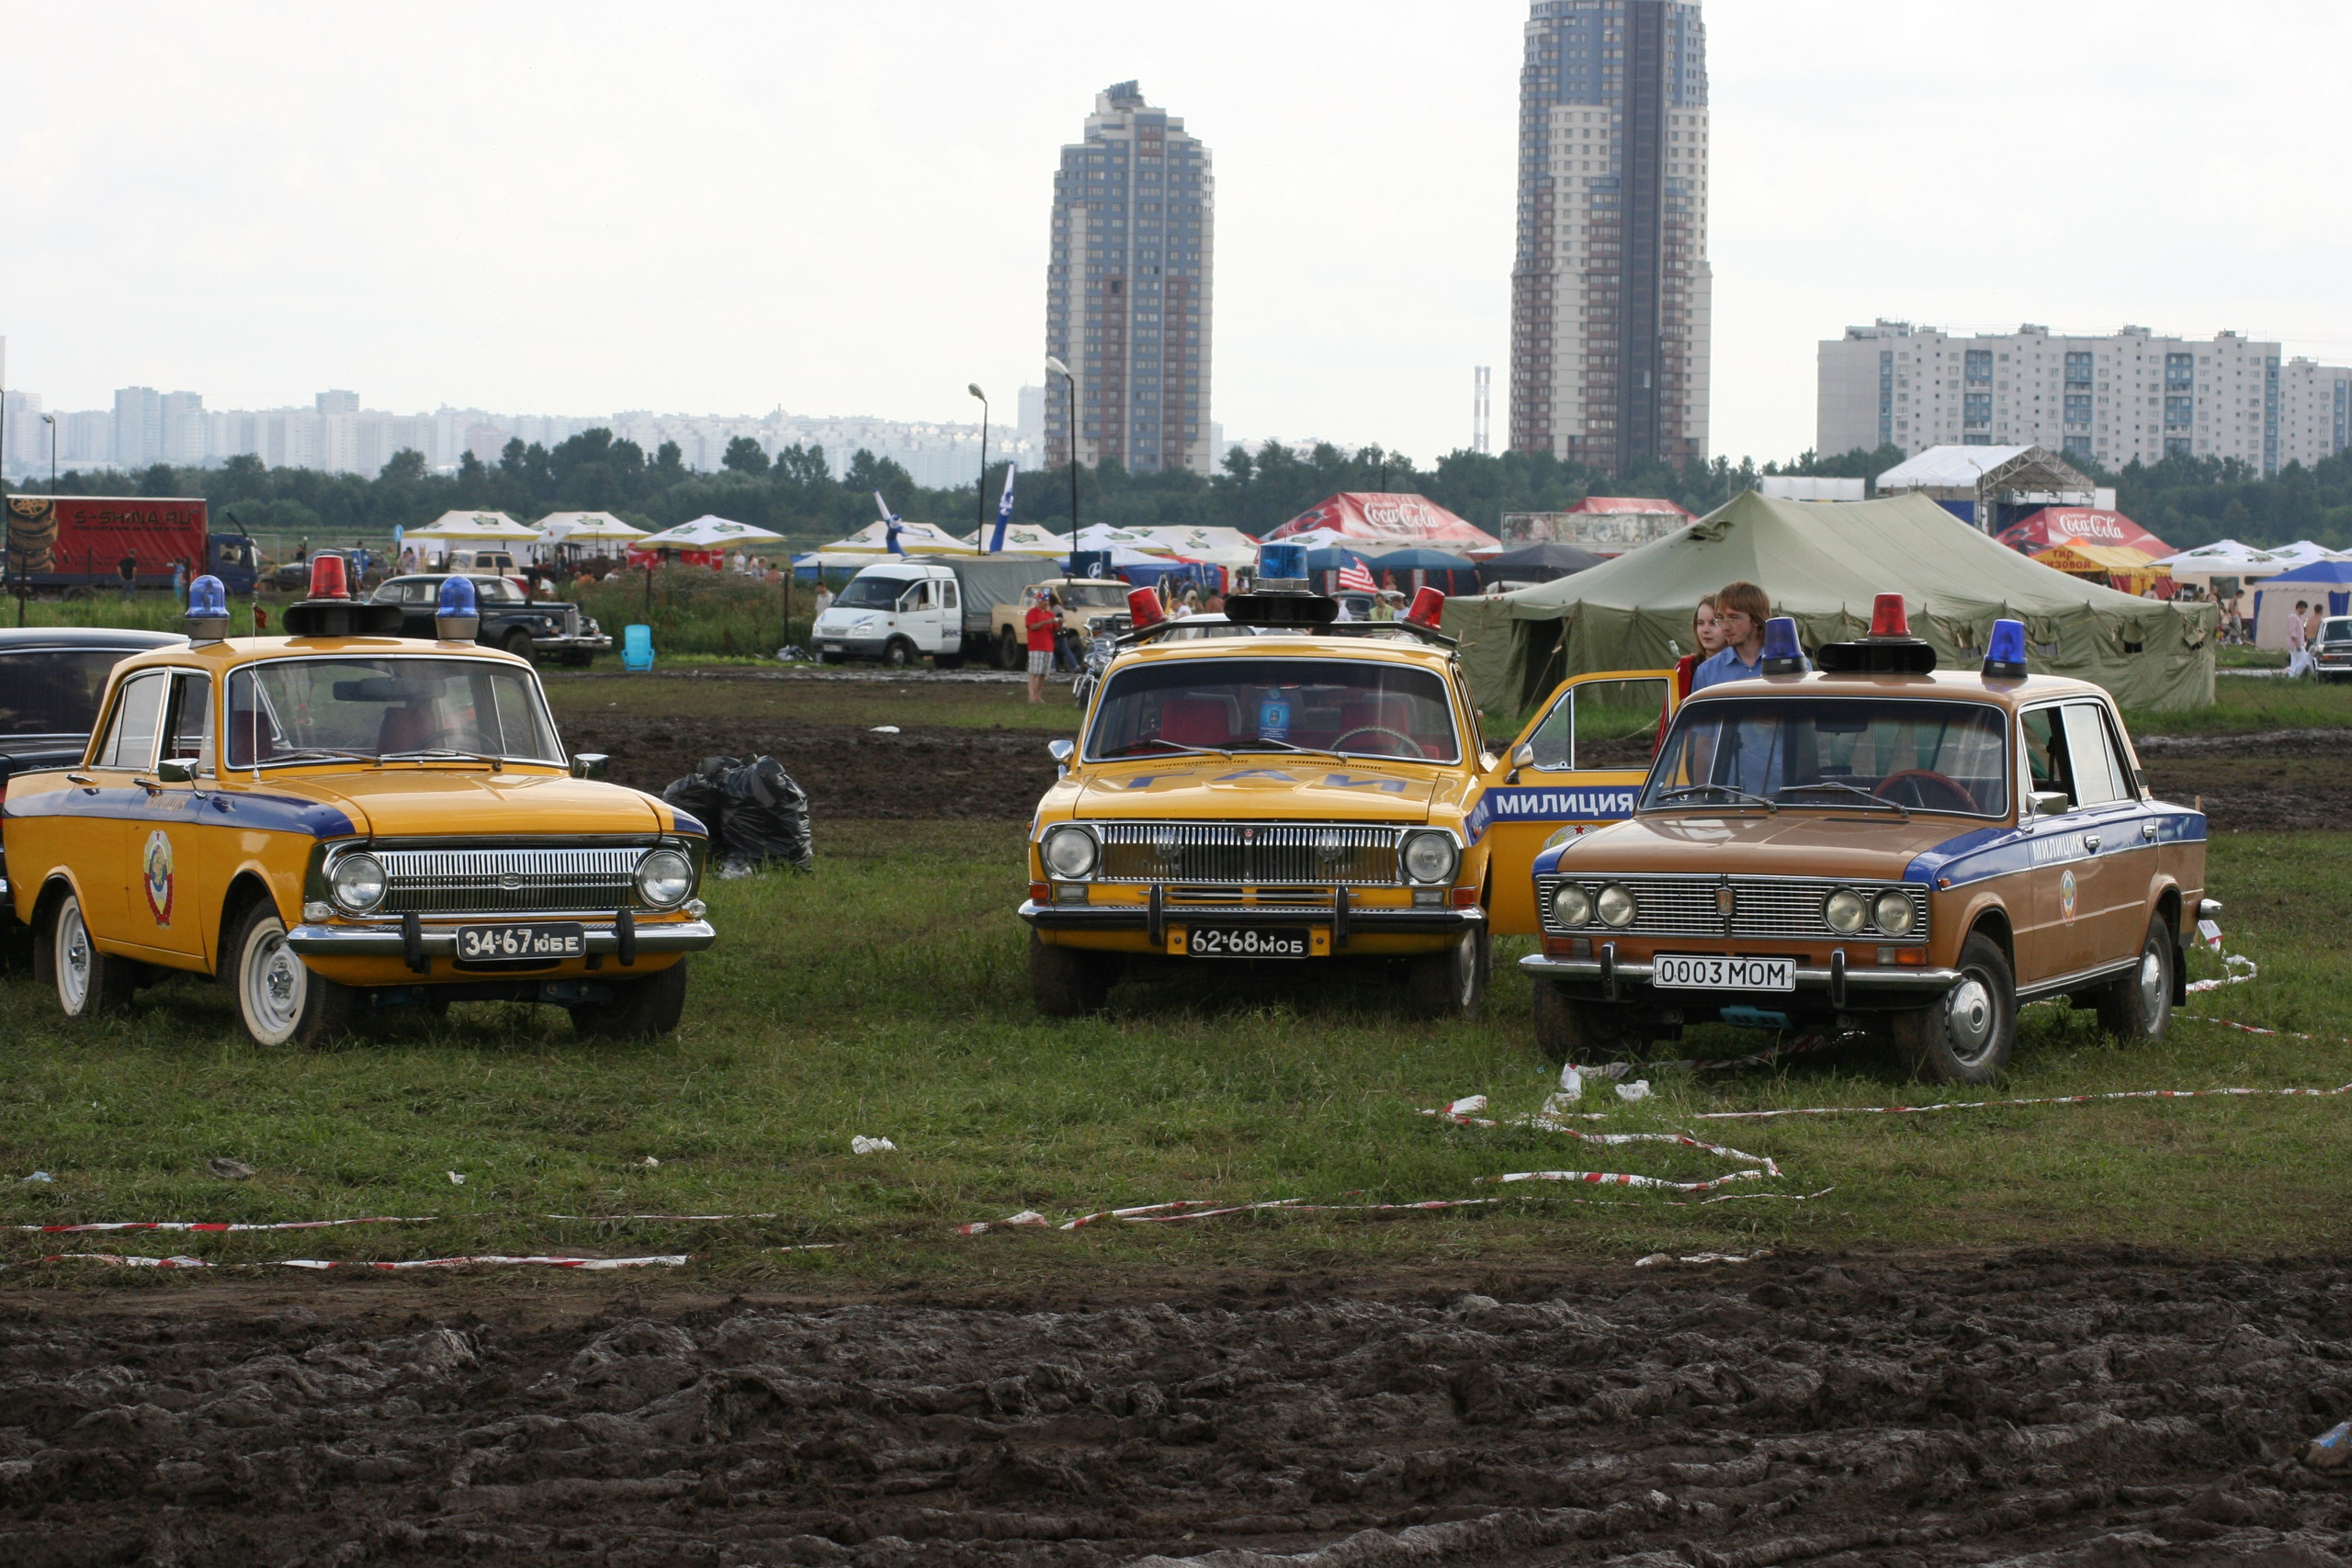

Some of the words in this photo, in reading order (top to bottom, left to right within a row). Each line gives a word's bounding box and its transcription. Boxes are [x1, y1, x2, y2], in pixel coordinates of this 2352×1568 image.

[1497, 793, 1634, 817] МИЛИЦИЯ
[2031, 833, 2084, 862] МИЛИЦИЯ
[1662, 960, 1723, 985] 0003
[1728, 962, 1785, 987] МОМ
